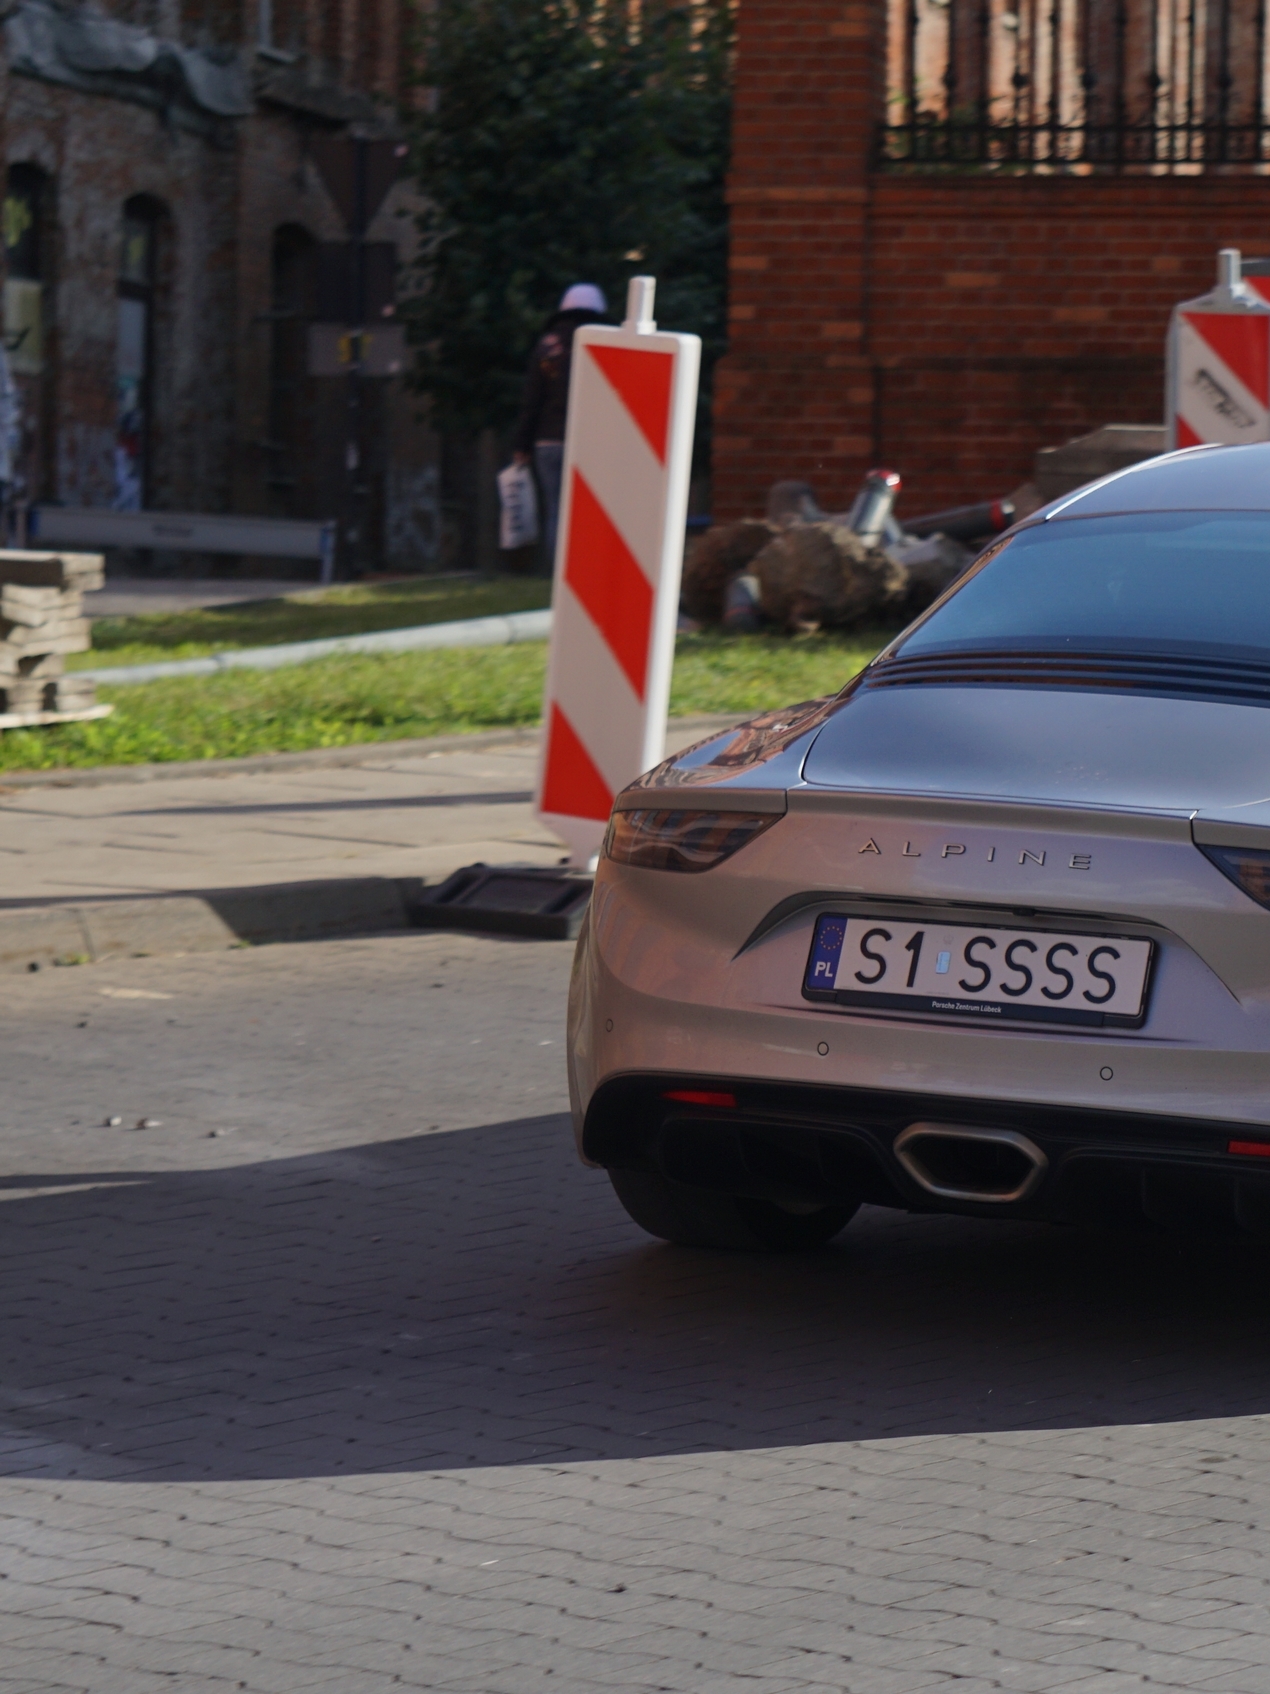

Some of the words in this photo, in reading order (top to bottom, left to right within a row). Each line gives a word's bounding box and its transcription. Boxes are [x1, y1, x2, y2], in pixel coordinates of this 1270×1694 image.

[858, 837, 1092, 870] ALPINE
[813, 961, 834, 978] PL
[854, 927, 926, 988] S1
[958, 935, 1121, 1005] SSSS
[931, 1000, 955, 1010] Porsche
[955, 1003, 980, 1012] Zentrum
[980, 1005, 1002, 1014] Lübeck
